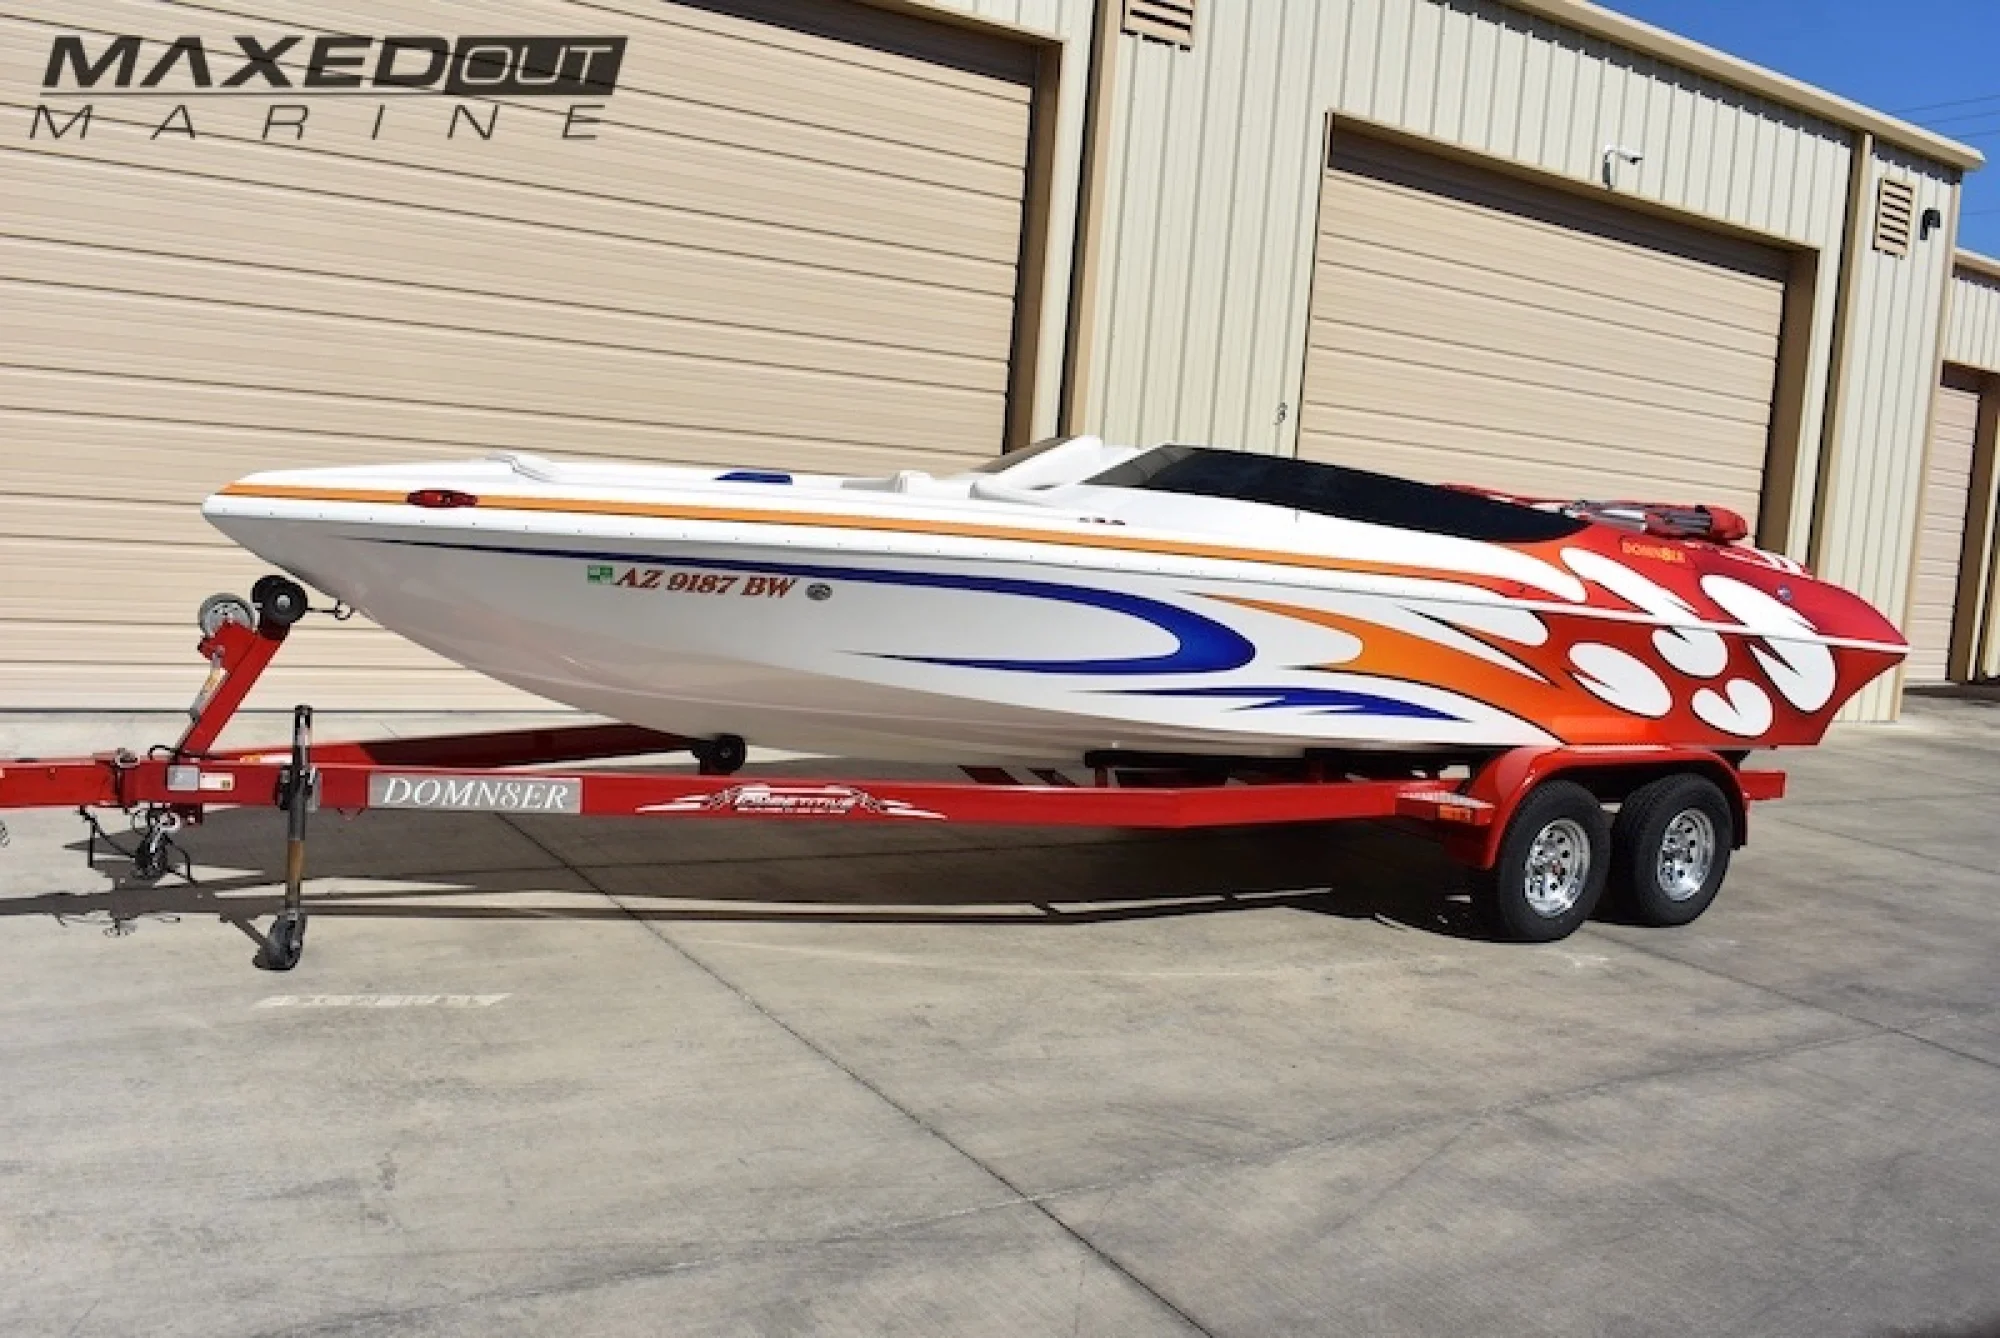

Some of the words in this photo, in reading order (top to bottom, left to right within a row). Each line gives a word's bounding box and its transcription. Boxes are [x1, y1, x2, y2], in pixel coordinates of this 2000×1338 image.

[614, 566, 665, 589] AZ
[667, 572, 740, 594] 9187
[741, 576, 799, 599] BW
[383, 777, 569, 809] DOMN8ER
